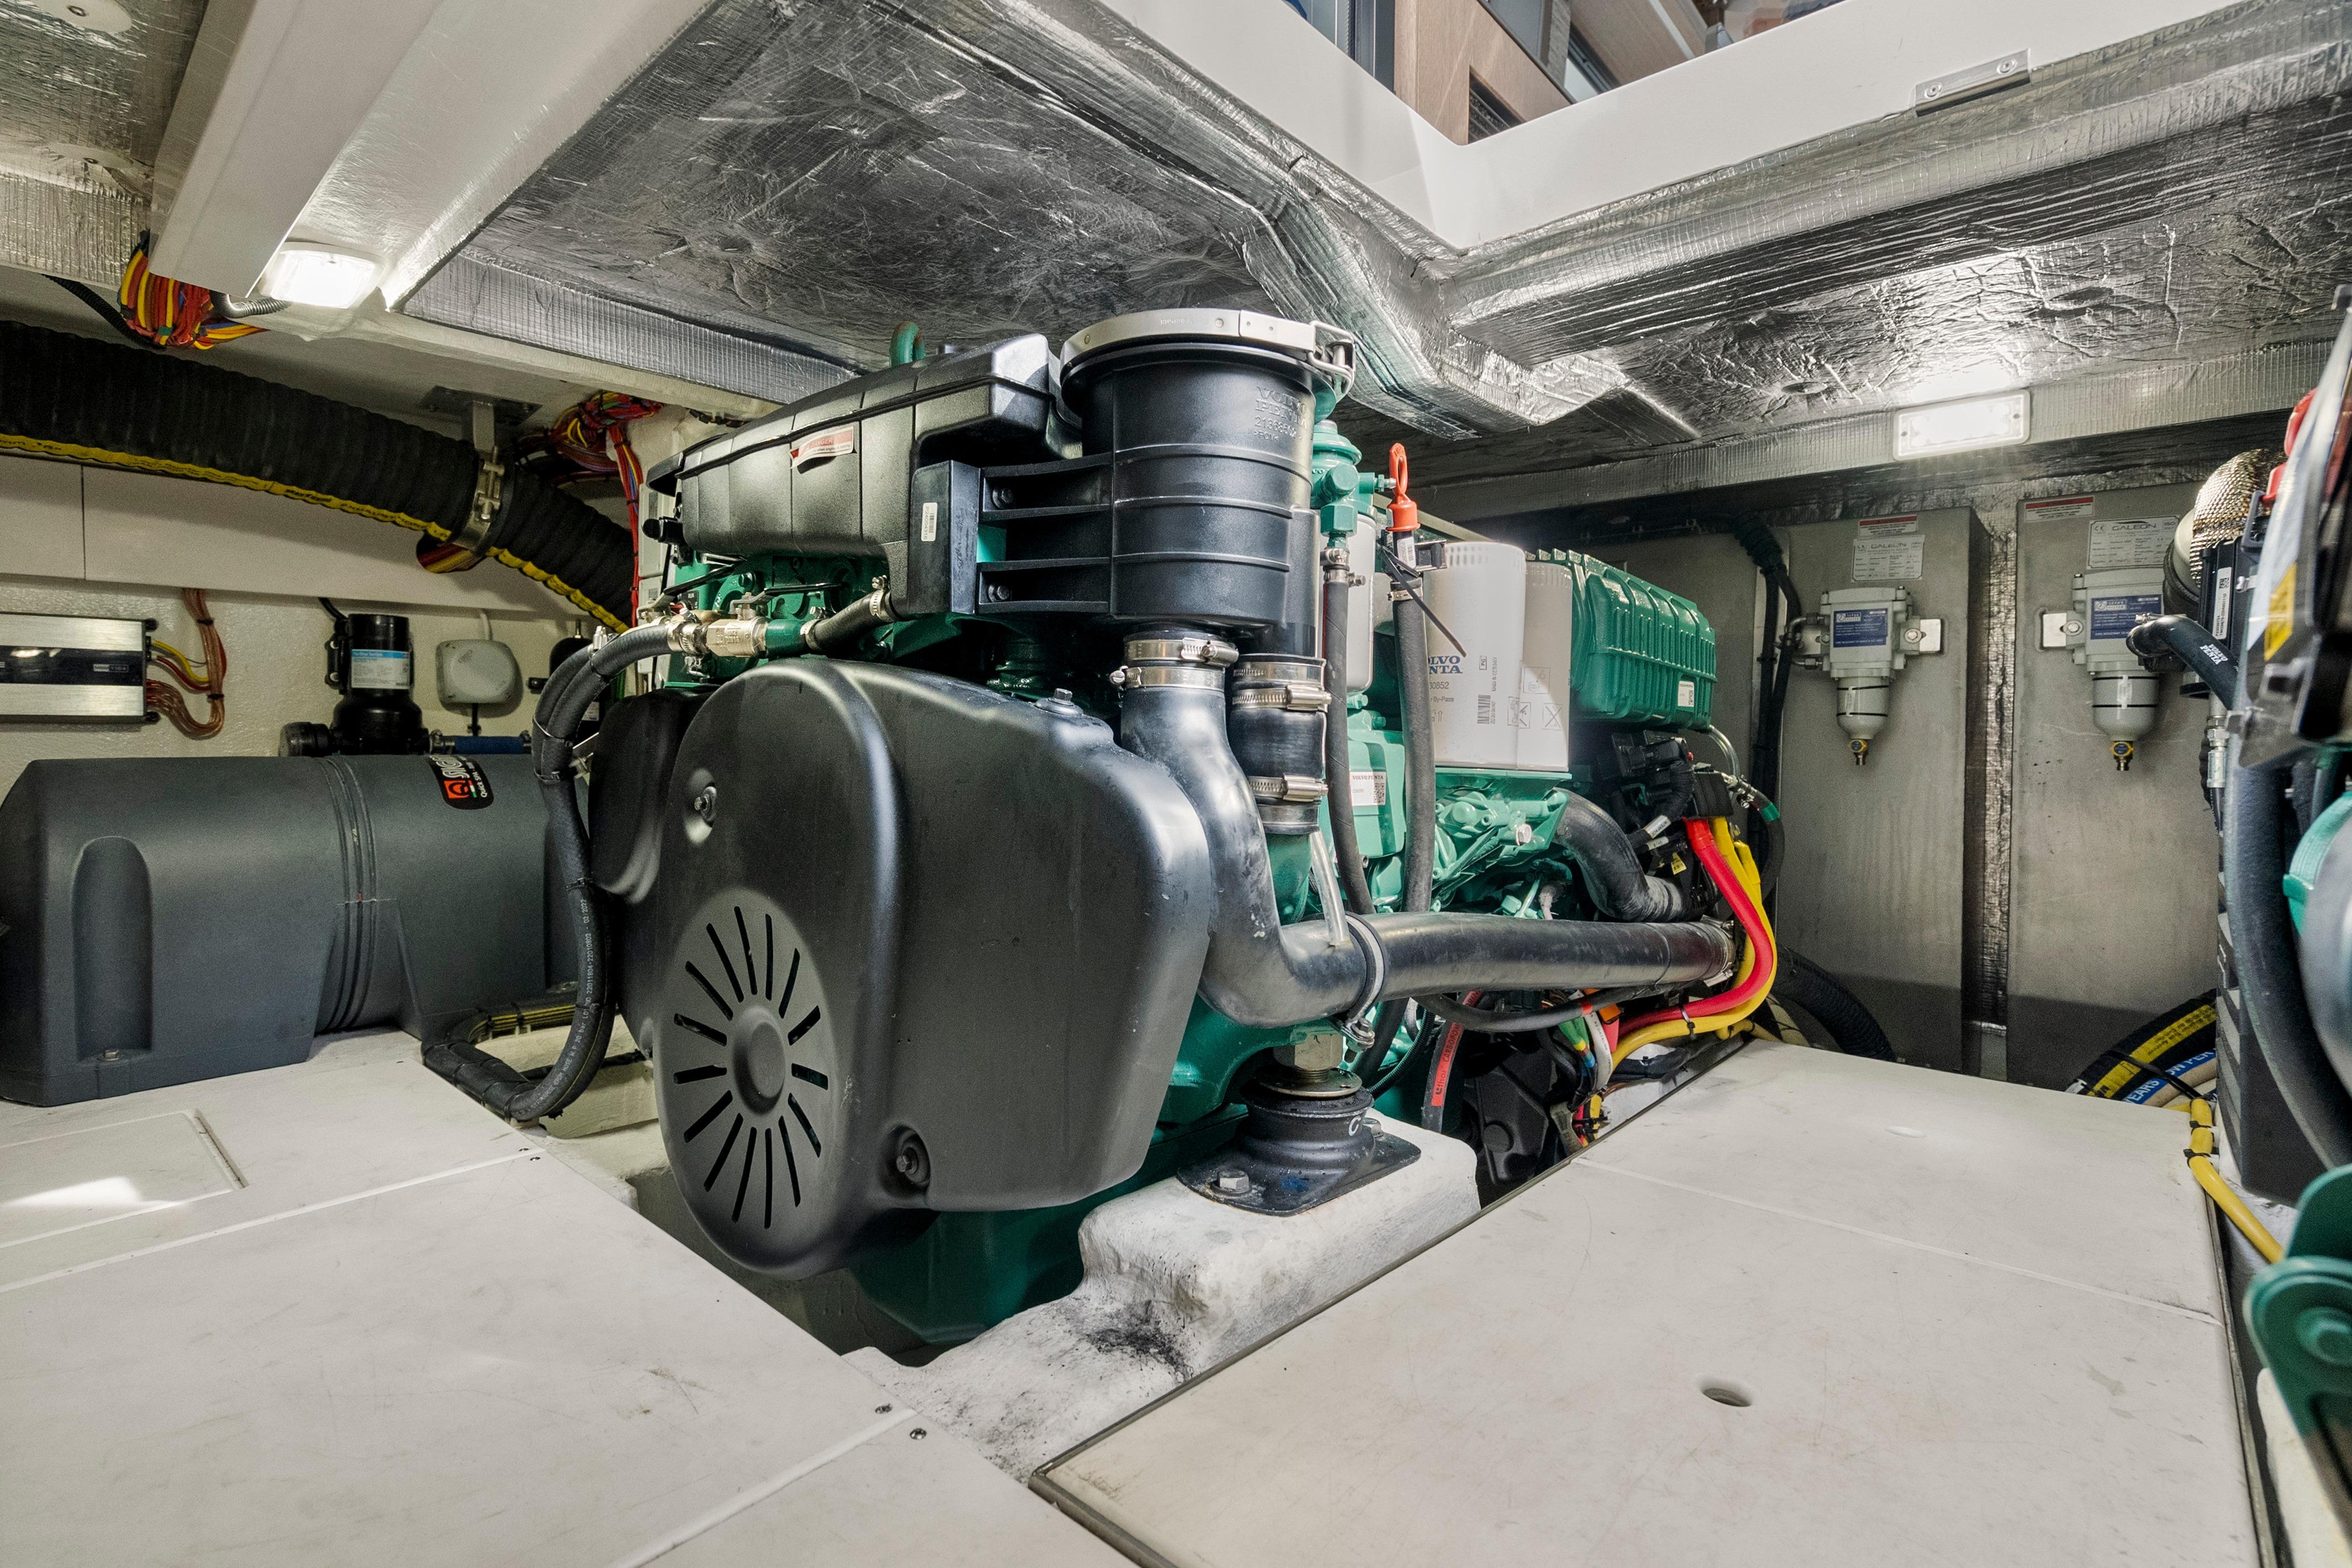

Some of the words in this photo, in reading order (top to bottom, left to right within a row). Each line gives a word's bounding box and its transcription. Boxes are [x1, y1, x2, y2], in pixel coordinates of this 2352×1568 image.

[1256, 386, 1306, 416] VOLVO
[1255, 398, 1307, 430] PENTA
[1428, 656, 1461, 664] LVO
[2199, 645, 2222, 665] PENTA
[2208, 643, 2228, 662] VOLVO
[1428, 665, 1463, 674] NTA
[477, 781, 488, 798] Quick
[561, 1058, 572, 1072] HOSE
[578, 1022, 586, 1033] bar
[1348, 1116, 1362, 1136] C
